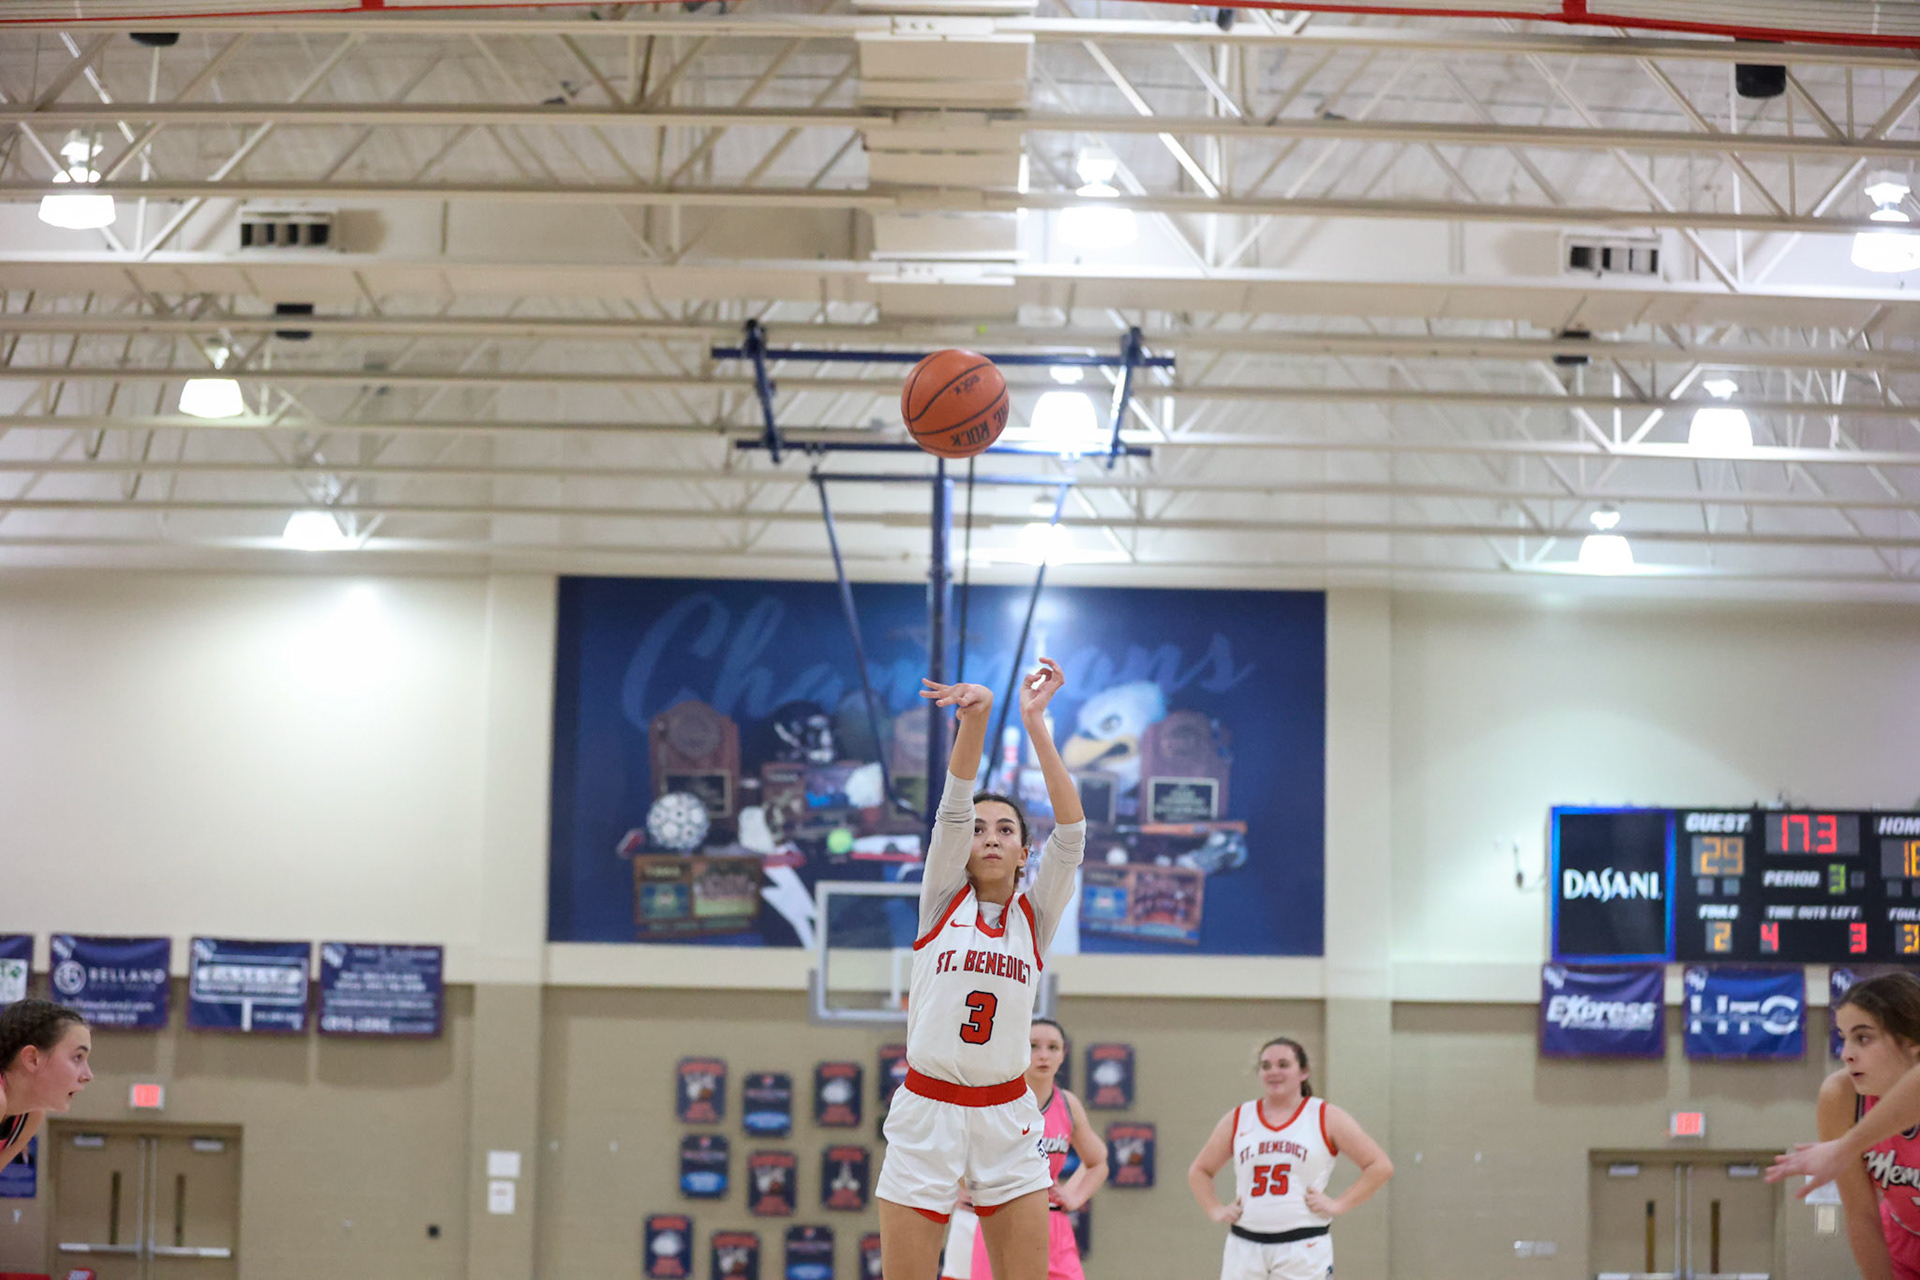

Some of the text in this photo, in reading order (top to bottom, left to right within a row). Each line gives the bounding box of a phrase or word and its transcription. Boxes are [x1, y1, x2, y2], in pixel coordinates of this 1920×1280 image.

[951, 419, 991, 447] ROCK
[620, 592, 1256, 735] Chamons
[1685, 812, 1750, 833] GUEST
[1700, 836, 1744, 875] 29
[1563, 867, 1659, 902] DASANI
[1763, 870, 1820, 887] PERIOD
[1829, 864, 1846, 893] 3
[1698, 904, 1740, 919] FOULS
[1768, 905, 1860, 919] TIME OUTS LEFT
[1714, 922, 1732, 951] 2
[1761, 922, 1779, 952] 4
[1850, 923, 1867, 953] 3
[936, 949, 1031, 986] ST. BENEDICT
[959, 990, 998, 1045] 3
[1690, 995, 1798, 1035] HTC
[1239, 1140, 1308, 1165] ST. BENEDICT
[1251, 1163, 1291, 1197] 55
